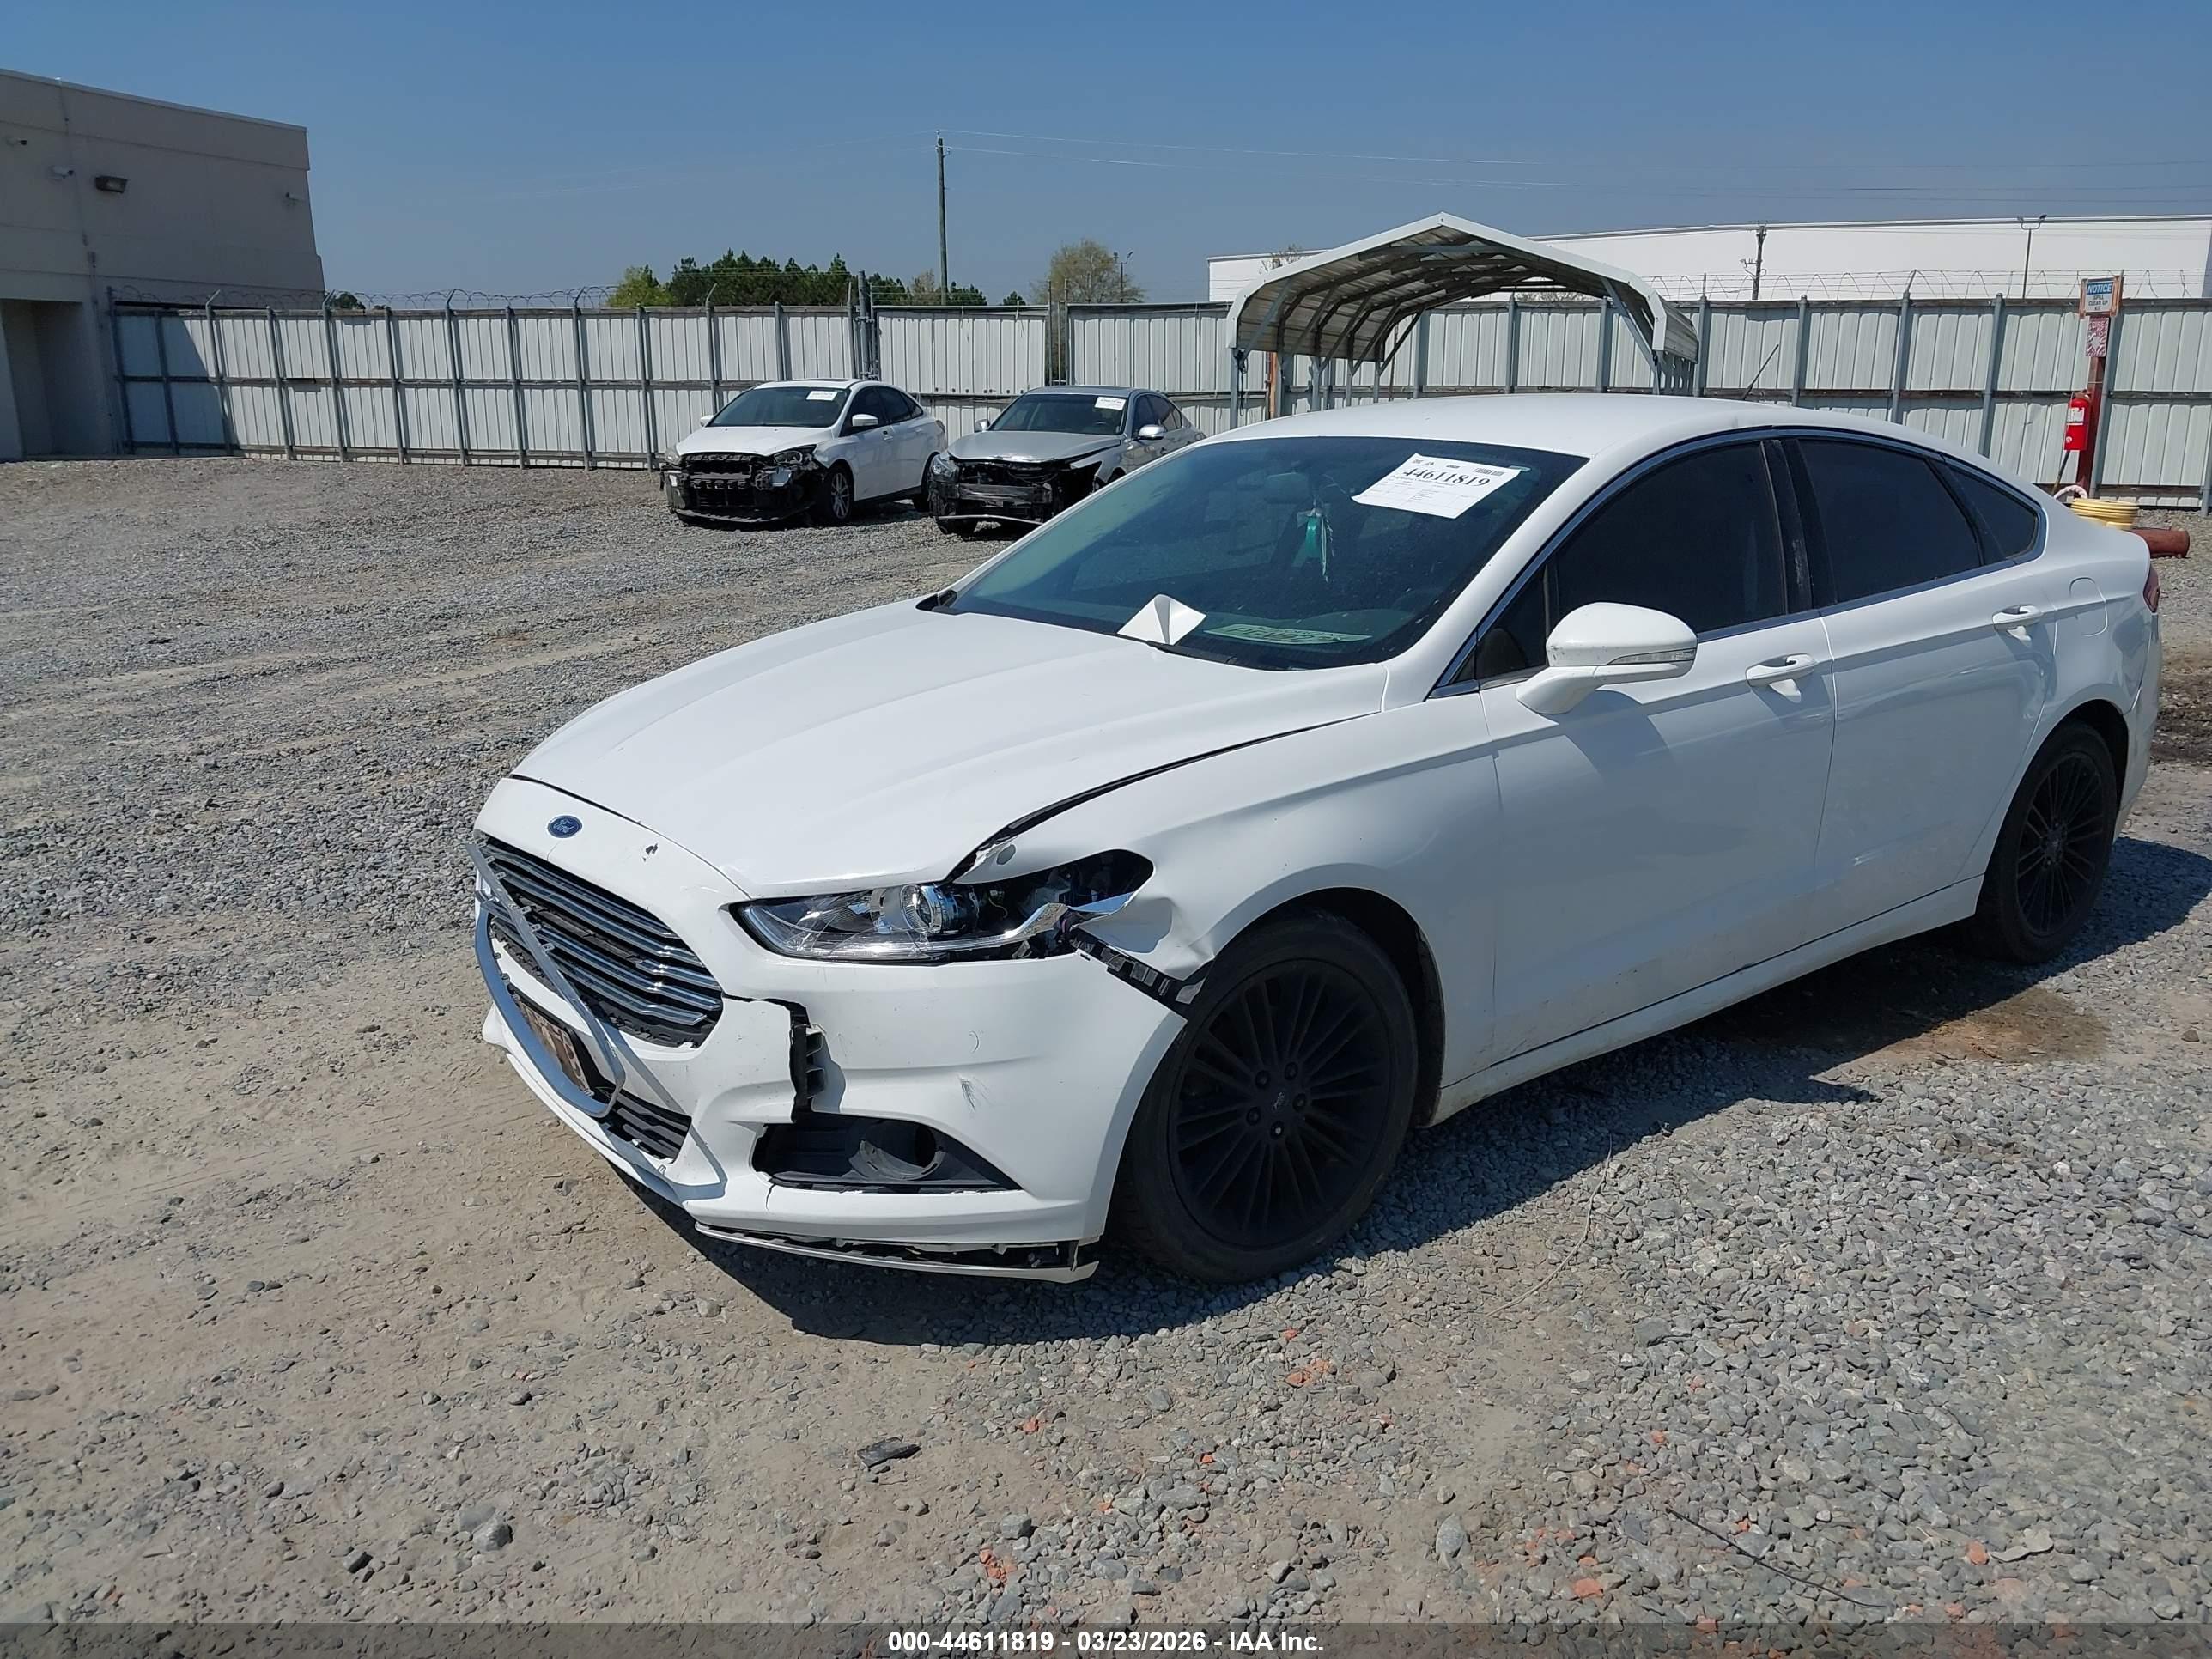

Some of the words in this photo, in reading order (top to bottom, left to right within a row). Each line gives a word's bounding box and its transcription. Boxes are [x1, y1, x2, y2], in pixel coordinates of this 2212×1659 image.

[2087, 284, 2112, 294] NOTICE
[1402, 468, 1491, 487] 44611819
[553, 819, 574, 833] Ford
